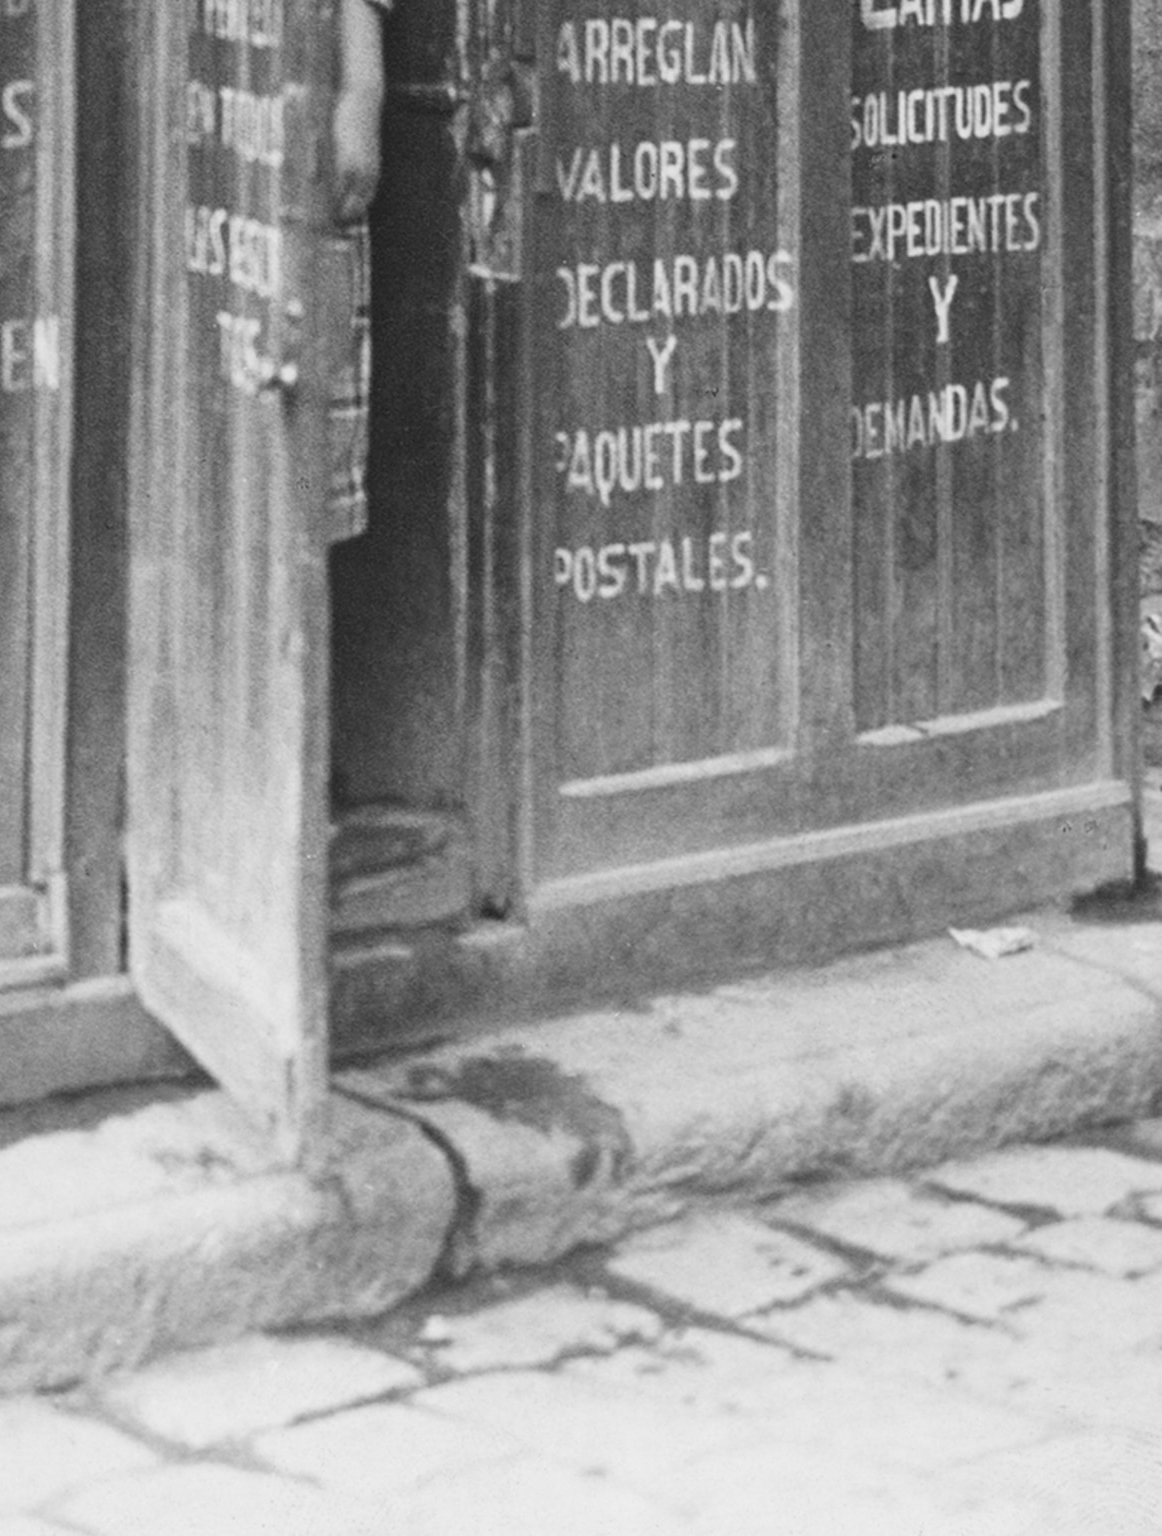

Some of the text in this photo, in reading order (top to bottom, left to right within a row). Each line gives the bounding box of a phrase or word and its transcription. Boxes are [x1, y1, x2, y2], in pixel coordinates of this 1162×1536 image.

[556, 17, 757, 86] ARREGLAN
[850, 80, 1031, 150] SOLICITUDES
[554, 137, 738, 202] VALORES
[851, 191, 1039, 263] EXPEDIENTES
[556, 250, 794, 330] DECLARADOS
[927, 274, 958, 343] Y
[645, 333, 677, 395] Y
[851, 375, 1020, 460] DEMANDAS.
